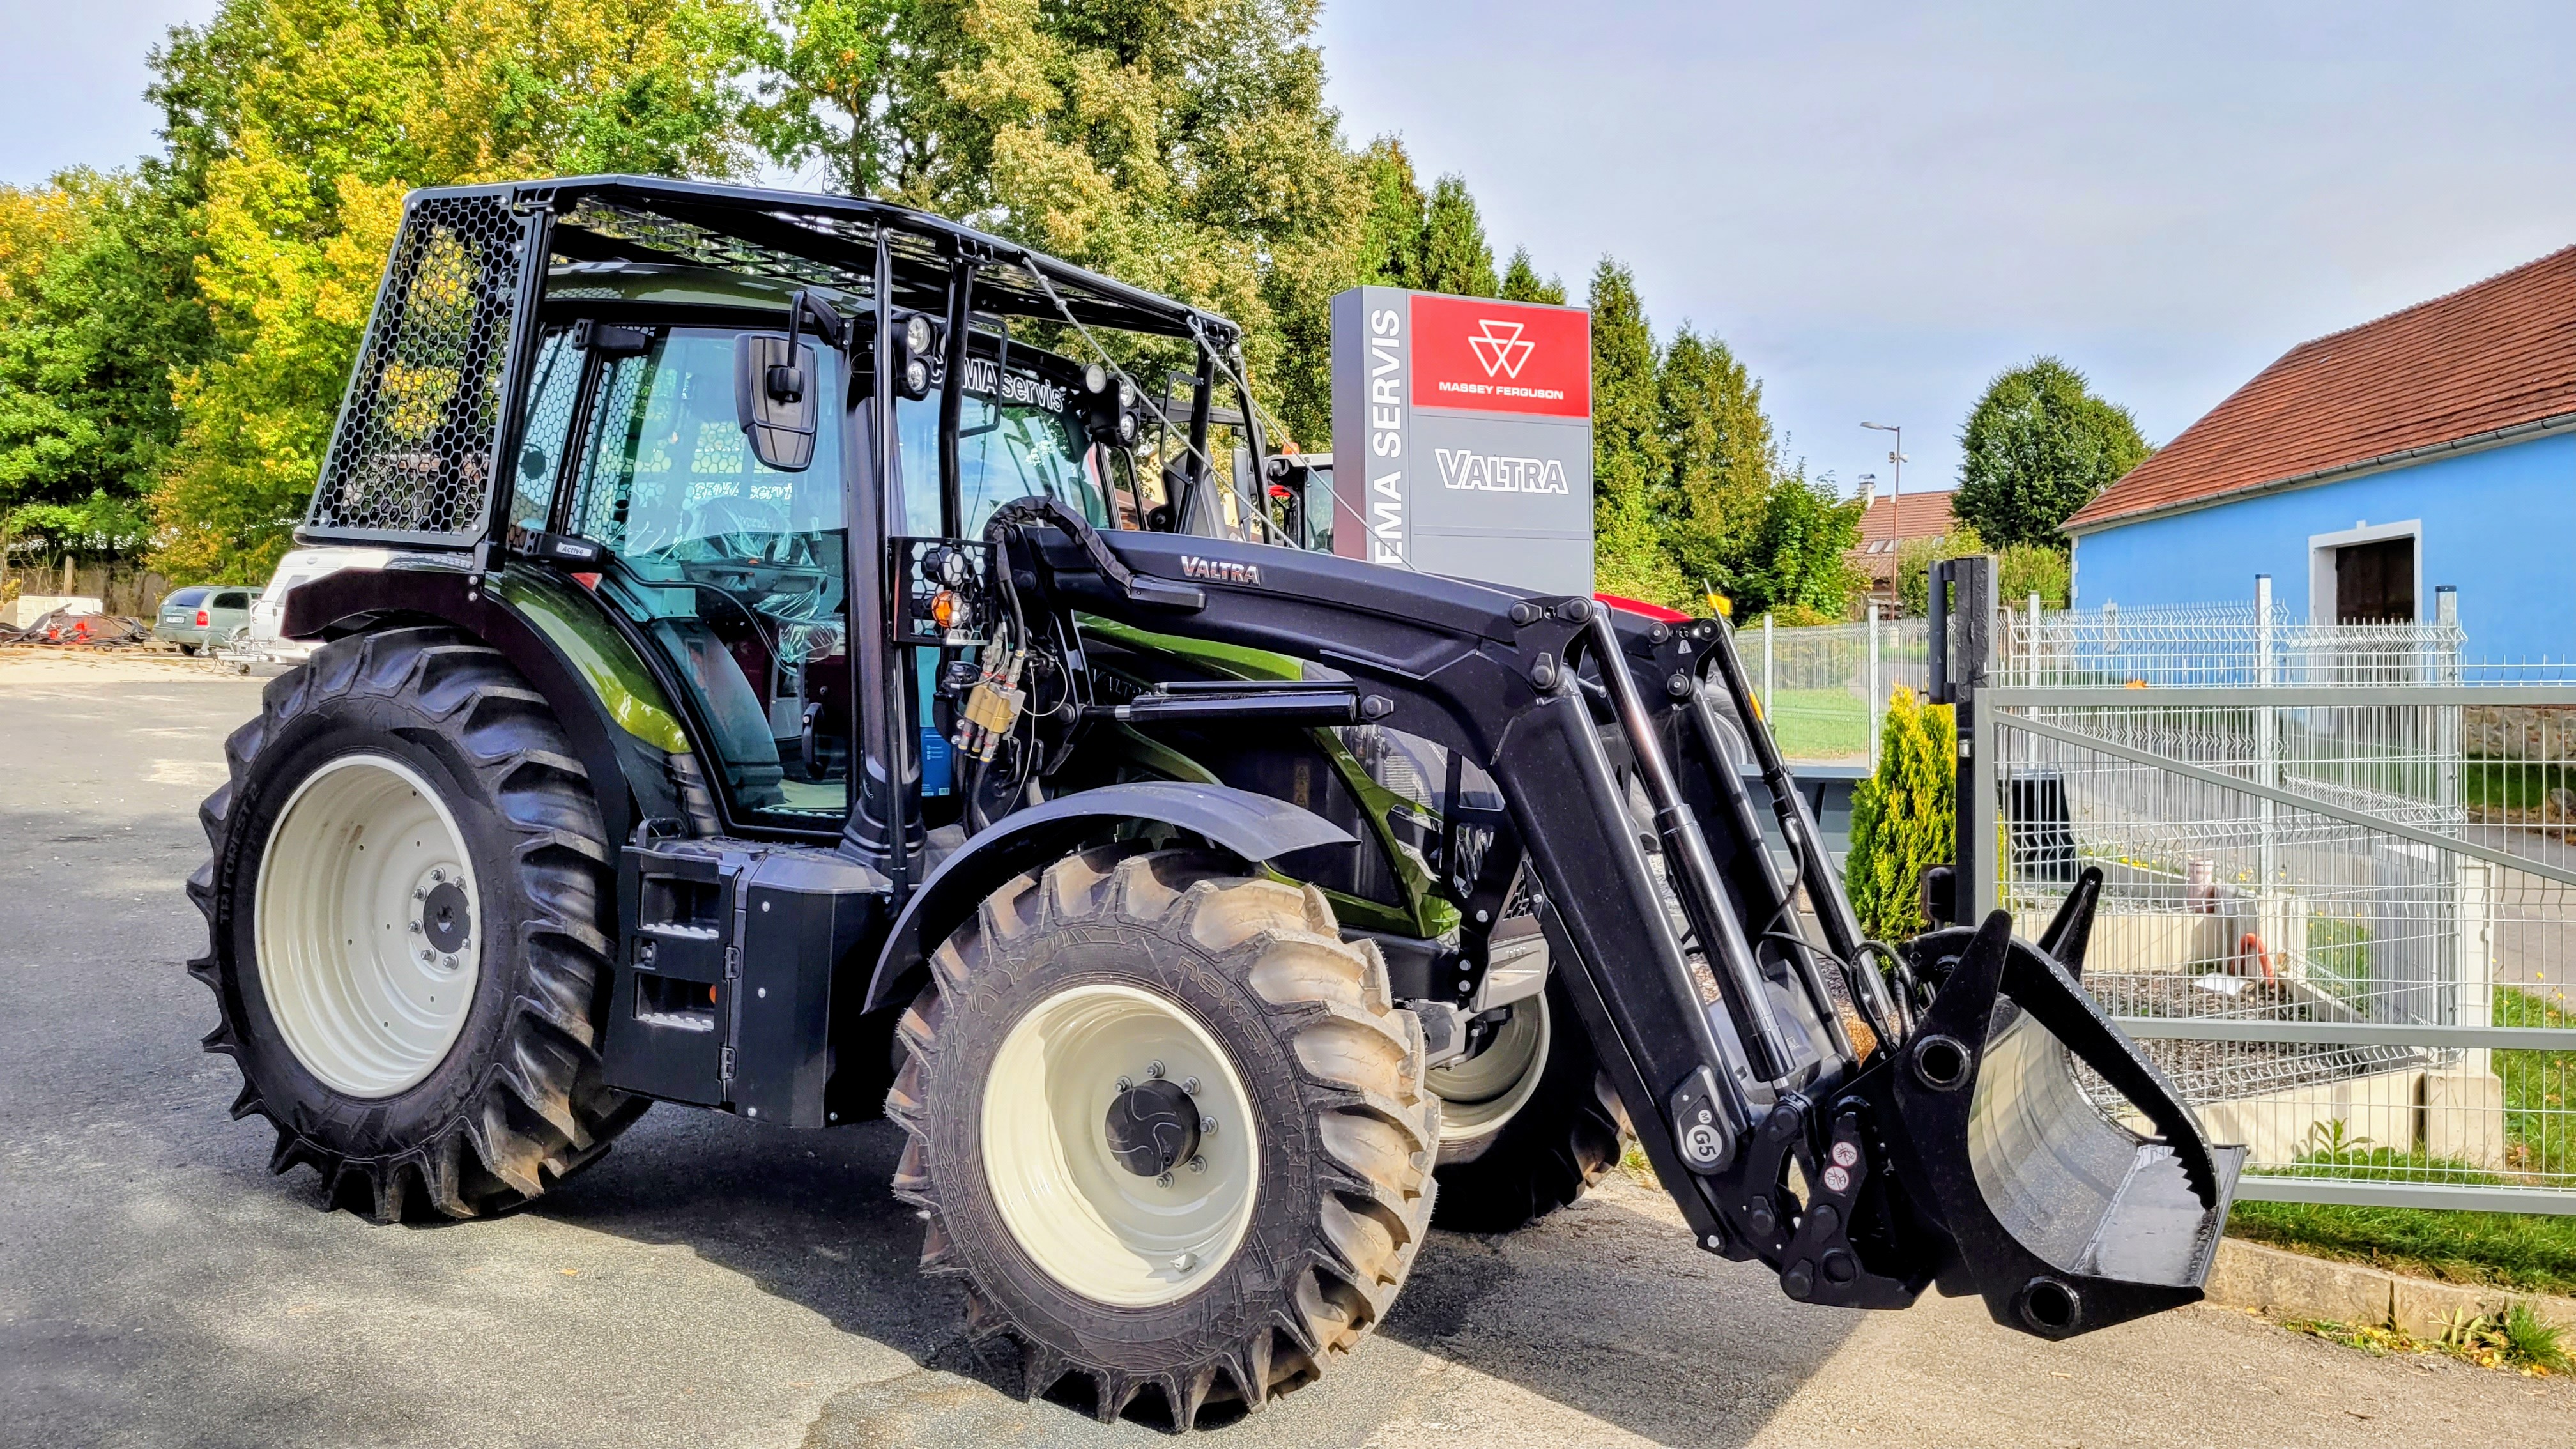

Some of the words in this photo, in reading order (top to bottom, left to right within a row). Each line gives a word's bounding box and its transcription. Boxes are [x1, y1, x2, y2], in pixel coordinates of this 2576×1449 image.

[1000, 372, 1064, 413] servis
[1370, 309, 1402, 459] SERVIS
[1439, 382, 1494, 394] MASSEY
[1496, 386, 1564, 400] FERGUSON
[1434, 448, 1569, 494] VALTRA
[562, 546, 584, 555] Active
[1181, 555, 1261, 586] VALTRA
[1693, 1130, 1717, 1156] G5
